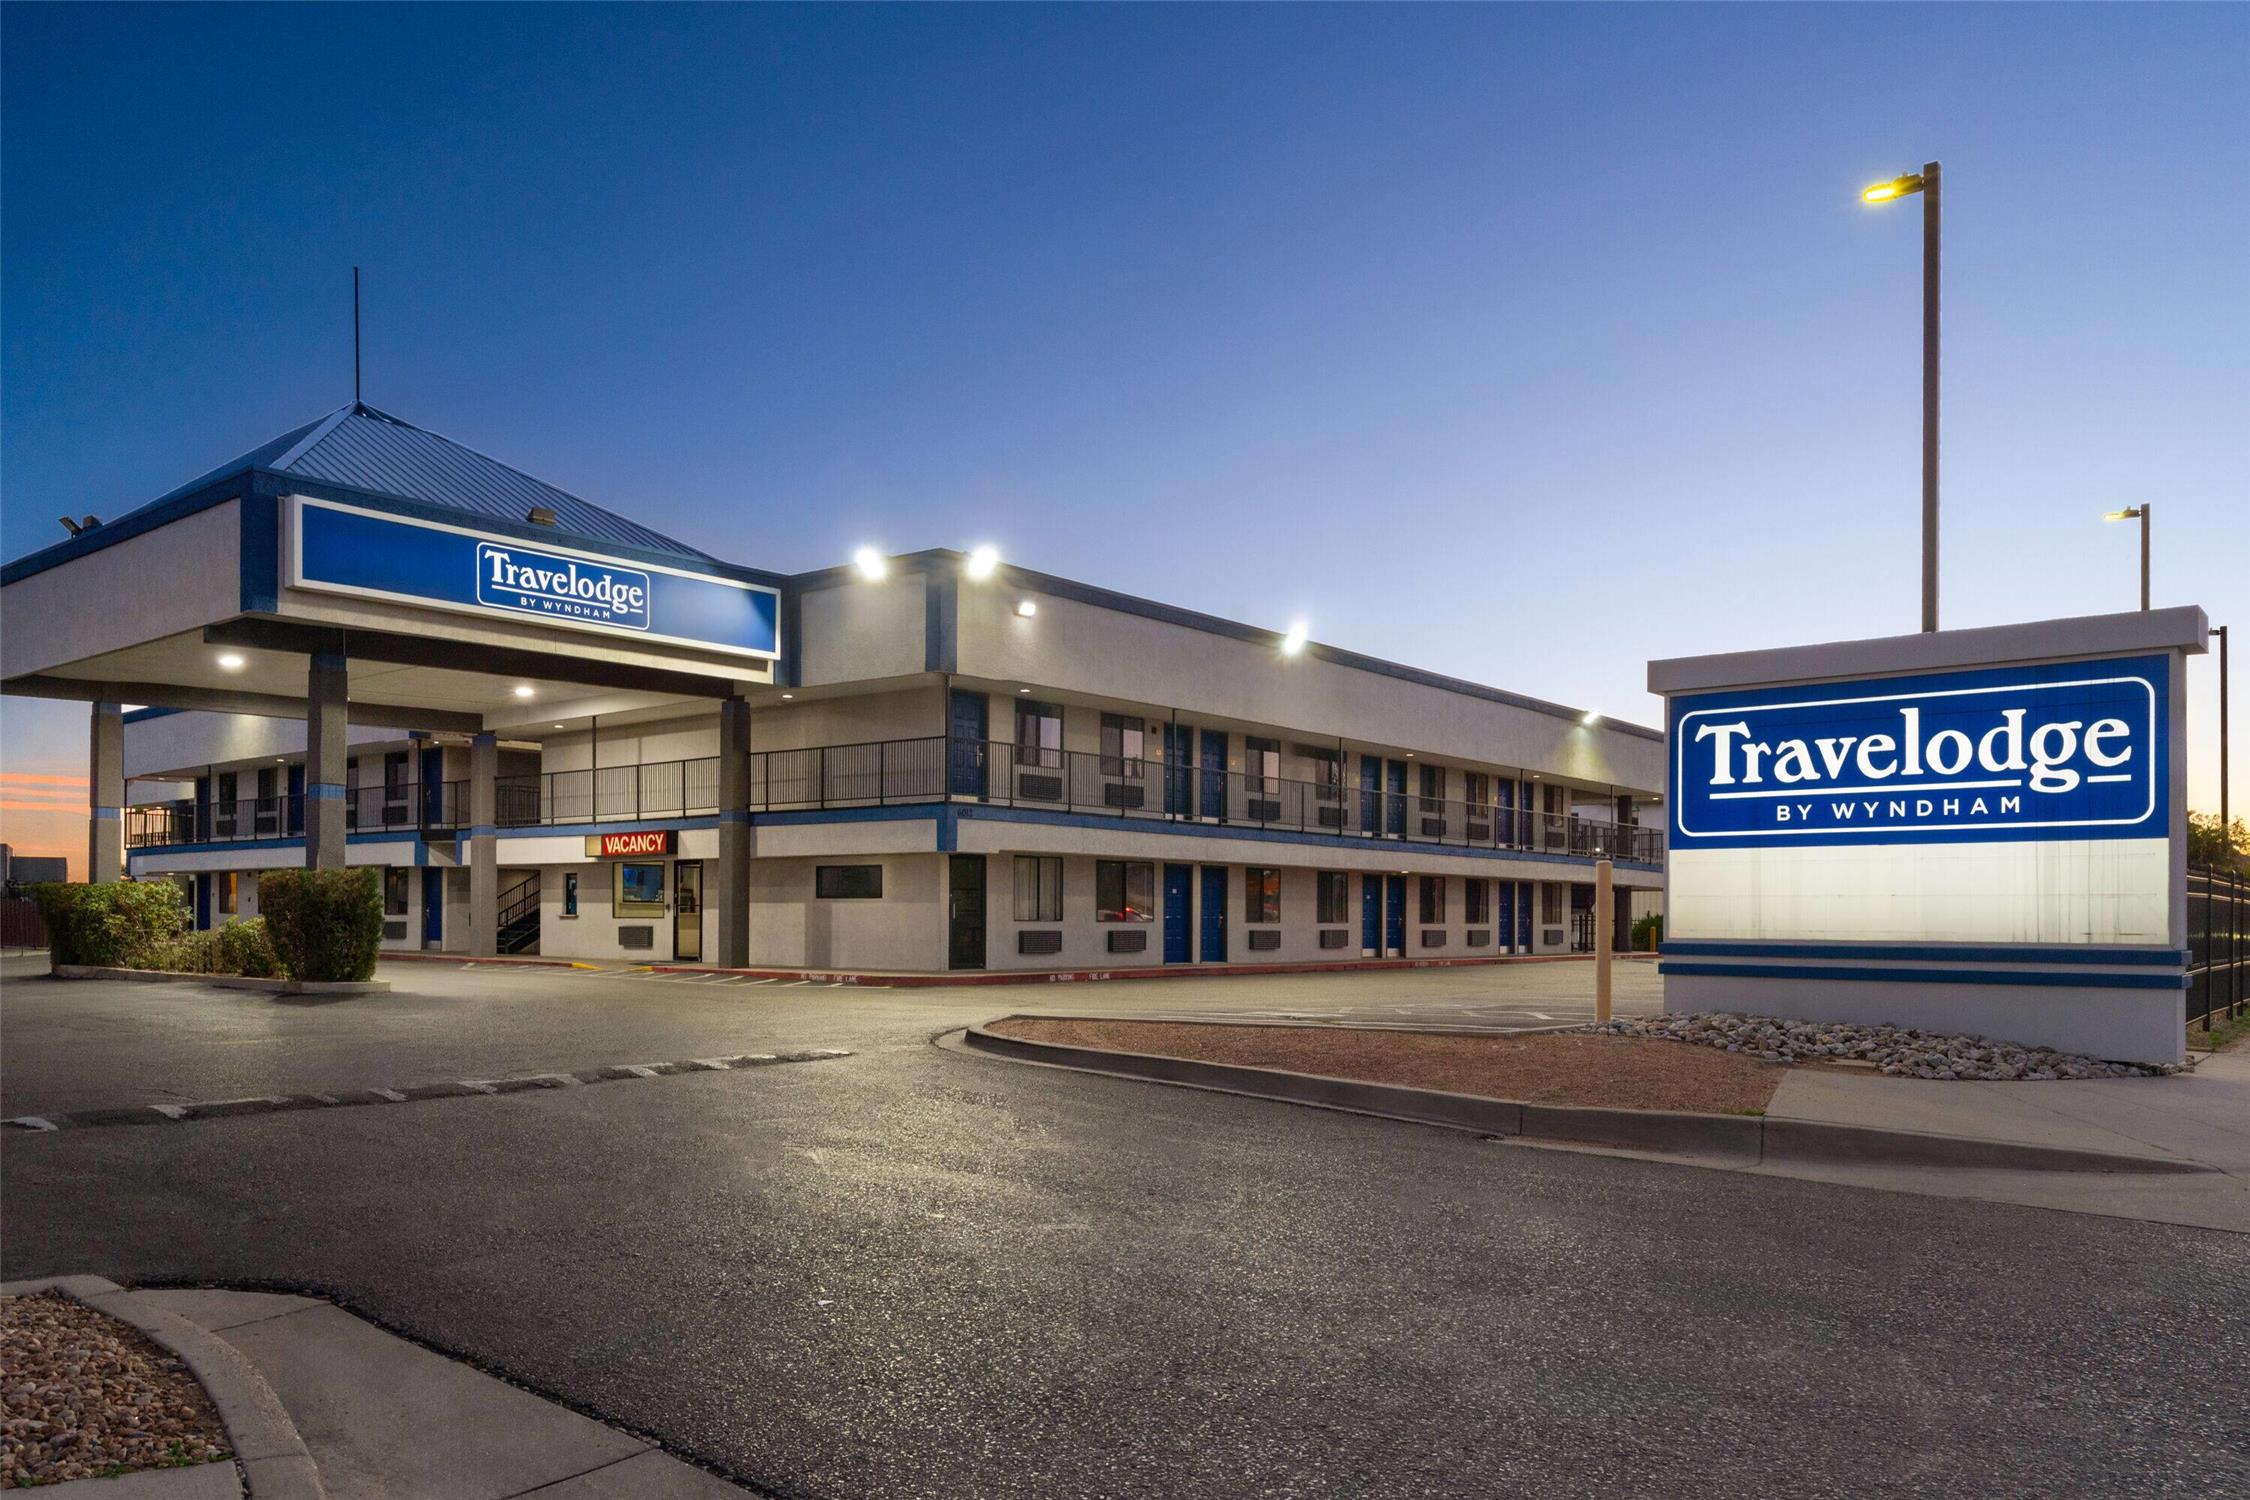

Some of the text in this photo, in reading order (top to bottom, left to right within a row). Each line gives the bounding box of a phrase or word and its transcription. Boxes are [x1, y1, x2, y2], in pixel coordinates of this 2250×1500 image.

[484, 549, 644, 614] Travelodge
[520, 597, 611, 619] BY WYNDHAM
[1695, 707, 2132, 793] Travelodge
[1776, 796, 2021, 822] BY WYNDHAM
[605, 833, 664, 854] VACANCY
